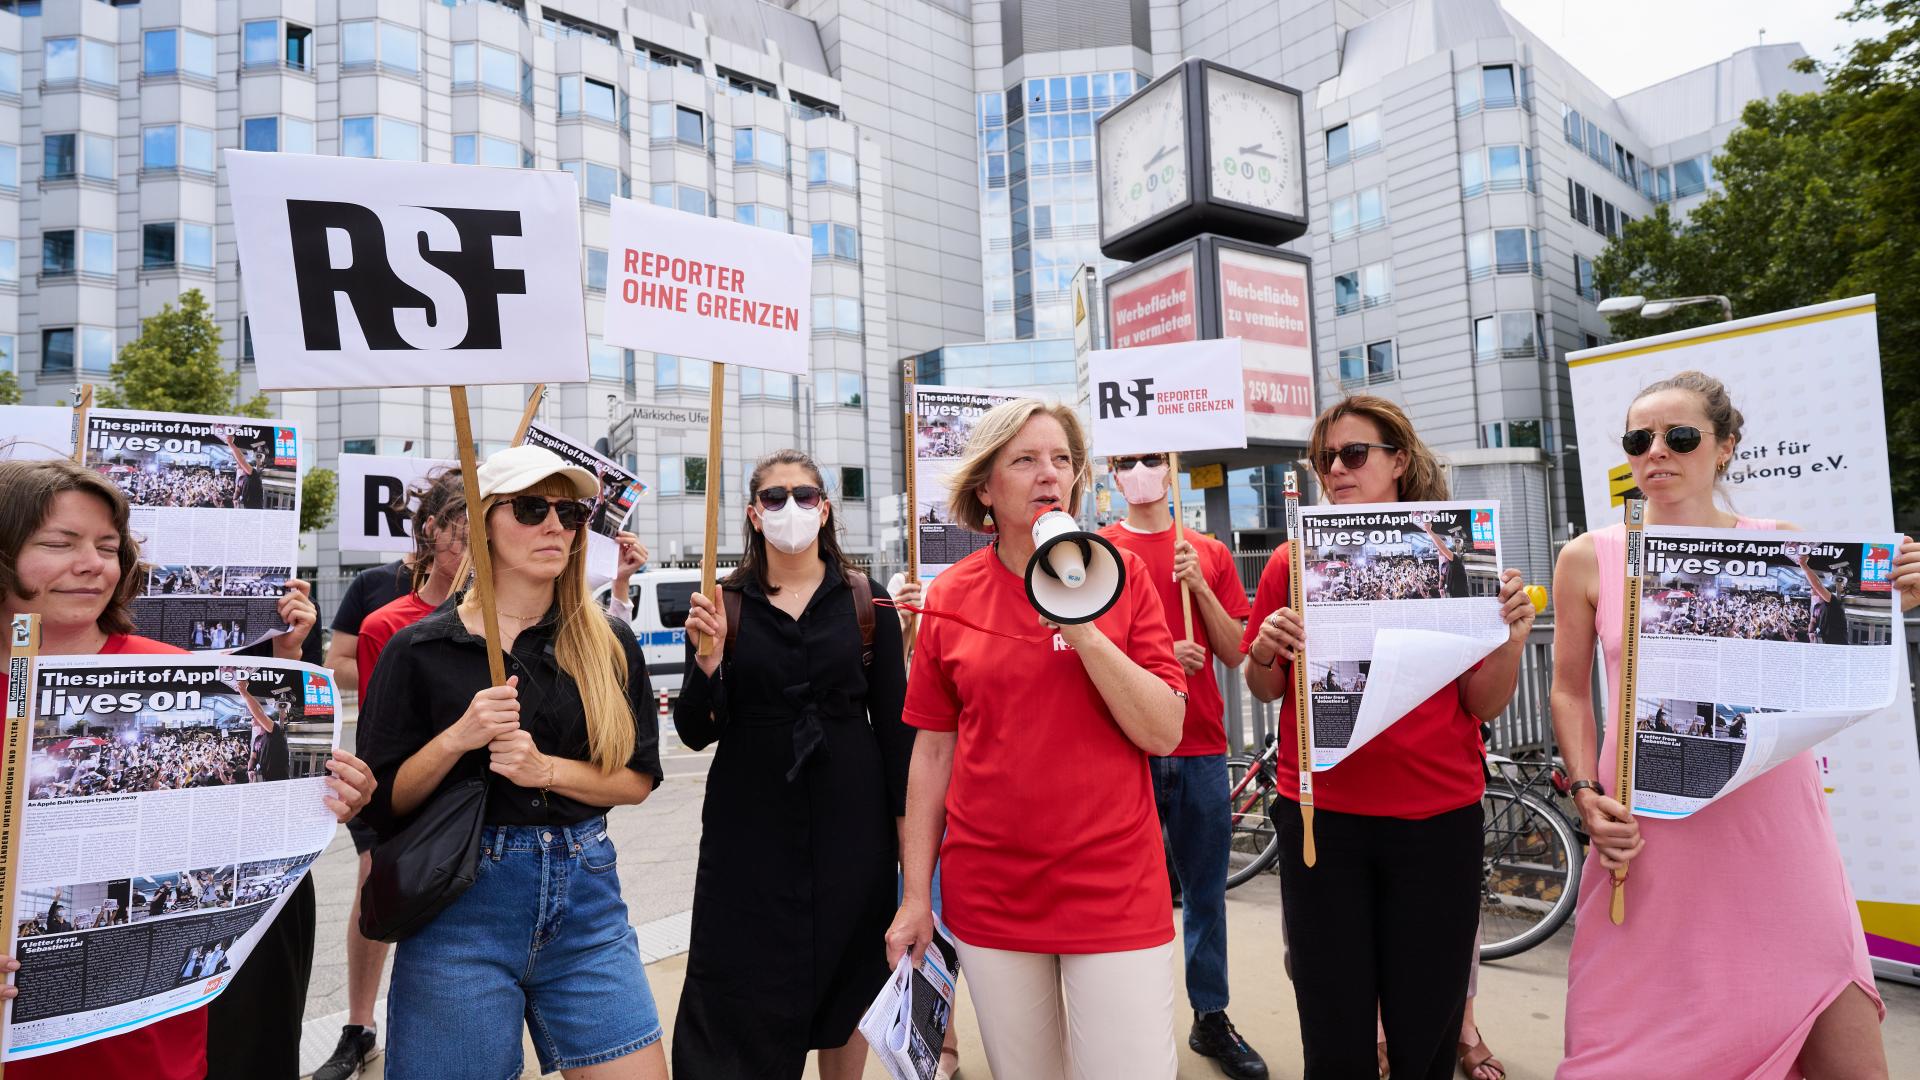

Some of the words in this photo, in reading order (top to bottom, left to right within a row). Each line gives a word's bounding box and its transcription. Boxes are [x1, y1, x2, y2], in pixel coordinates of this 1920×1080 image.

[286, 199, 526, 351] RSF
[624, 248, 745, 293] REPORTER
[1226, 279, 1299, 307] Werbefläche
[622, 278, 688, 313] OHNE
[697, 292, 799, 332] GRENZEN
[1116, 288, 1187, 326] Werbefläche
[1117, 336, 1131, 348] zu
[1133, 312, 1192, 344] vermieten
[1228, 309, 1242, 322] zu
[1245, 310, 1304, 332] vermieten
[918, 393, 935, 402] The
[936, 394, 960, 403] spirit
[960, 395, 970, 403] of
[970, 396, 994, 405] Apple
[1098, 377, 1155, 419] RSF
[1157, 389, 1208, 402] REPORTER
[1248, 380, 1268, 402] 259
[1270, 382, 1289, 404] 267
[1291, 385, 1309, 405] 111
[632, 408, 686, 422] Märkisches
[688, 412, 709, 423] Ufer
[918, 402, 960, 416] lives
[961, 406, 984, 417] on
[1157, 403, 1185, 415] OHNE
[1187, 399, 1234, 413] GRENZEN
[91, 419, 122, 430] The
[122, 420, 163, 433] spirit
[164, 422, 180, 433] of
[181, 423, 223, 437] Apple
[224, 425, 260, 439] Daily
[90, 431, 161, 452] lives
[164, 437, 202, 453] on
[1777, 441, 1811, 456] für
[527, 427, 543, 441] The
[544, 436, 569, 453] spirit
[567, 447, 579, 456] of
[577, 451, 602, 468] Apple
[603, 465, 626, 481] Daily
[1811, 455, 1848, 472] e.V.
[1305, 517, 1330, 527] The
[1331, 515, 1366, 528] spirit
[1367, 514, 1382, 525] of
[1382, 513, 1421, 527] Apple
[1423, 512, 1457, 525] Daily
[1306, 528, 1367, 547] lives
[1369, 529, 1403, 544] on
[1648, 539, 1678, 551] The
[1679, 541, 1724, 554] spirit
[1725, 542, 1744, 553] of
[1744, 543, 1795, 557] Apple
[1798, 544, 1844, 558] Daily
[1648, 552, 1721, 575] lives
[1725, 560, 1767, 576] on
[43, 672, 84, 686] The
[86, 670, 146, 687] spirit
[148, 669, 172, 683] of
[173, 669, 233, 685] Apple
[236, 670, 285, 684] Daily
[40, 689, 143, 716] lives
[148, 690, 201, 712] on
[3, 767, 15, 828] UNTERDRÜCKUNG
[11, 719, 19, 746] FOLTER.
[25, 943, 69, 954] Sebastien
[29, 939, 55, 947] letter
[55, 936, 77, 944] from
